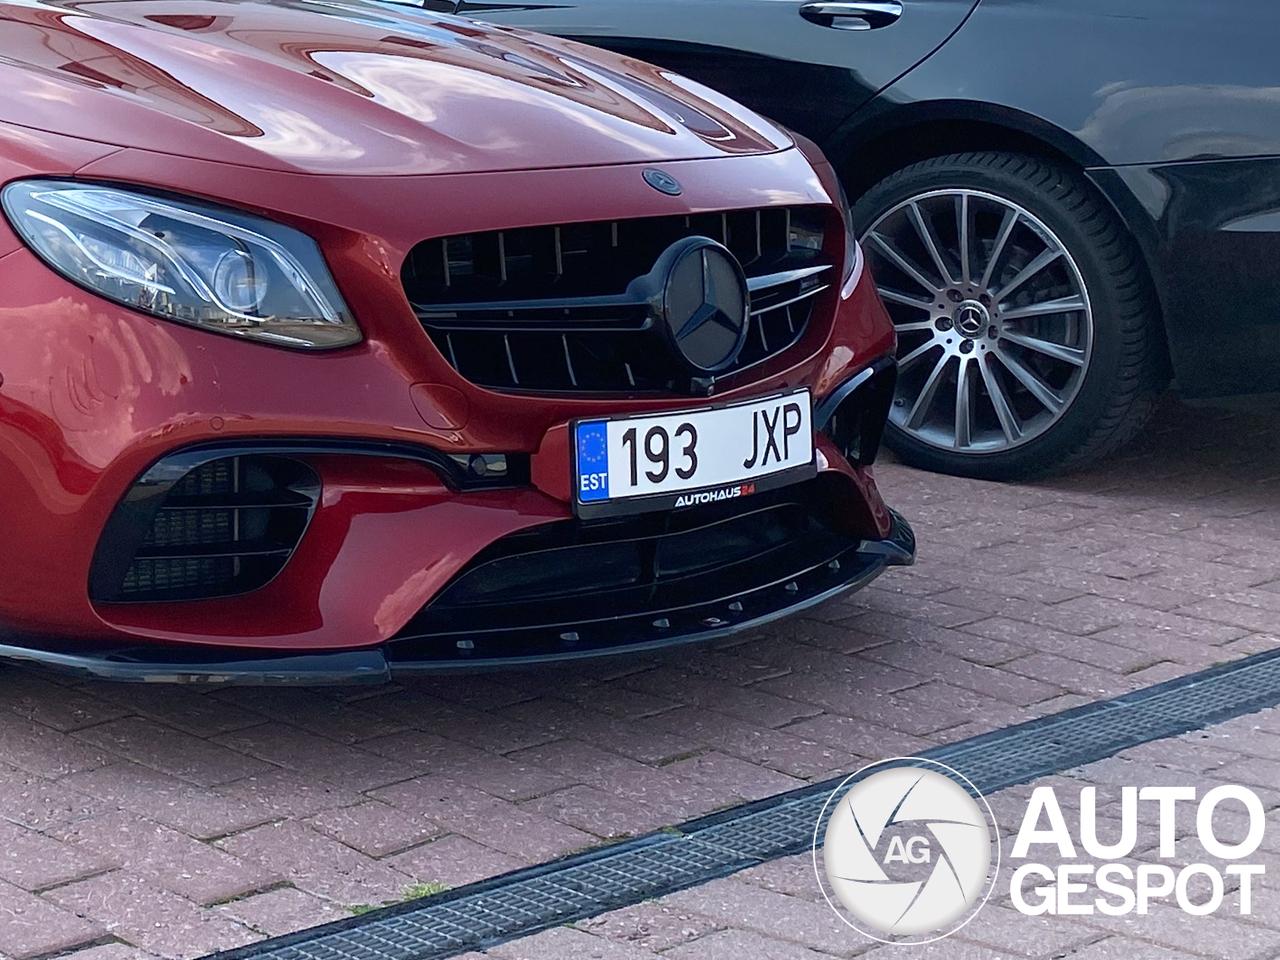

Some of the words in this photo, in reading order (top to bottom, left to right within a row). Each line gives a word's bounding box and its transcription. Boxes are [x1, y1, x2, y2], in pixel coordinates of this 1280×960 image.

[621, 422, 698, 487] 193
[742, 402, 801, 469] JXP
[580, 472, 607, 491] EST
[674, 484, 755, 508] AUTOHAUS24
